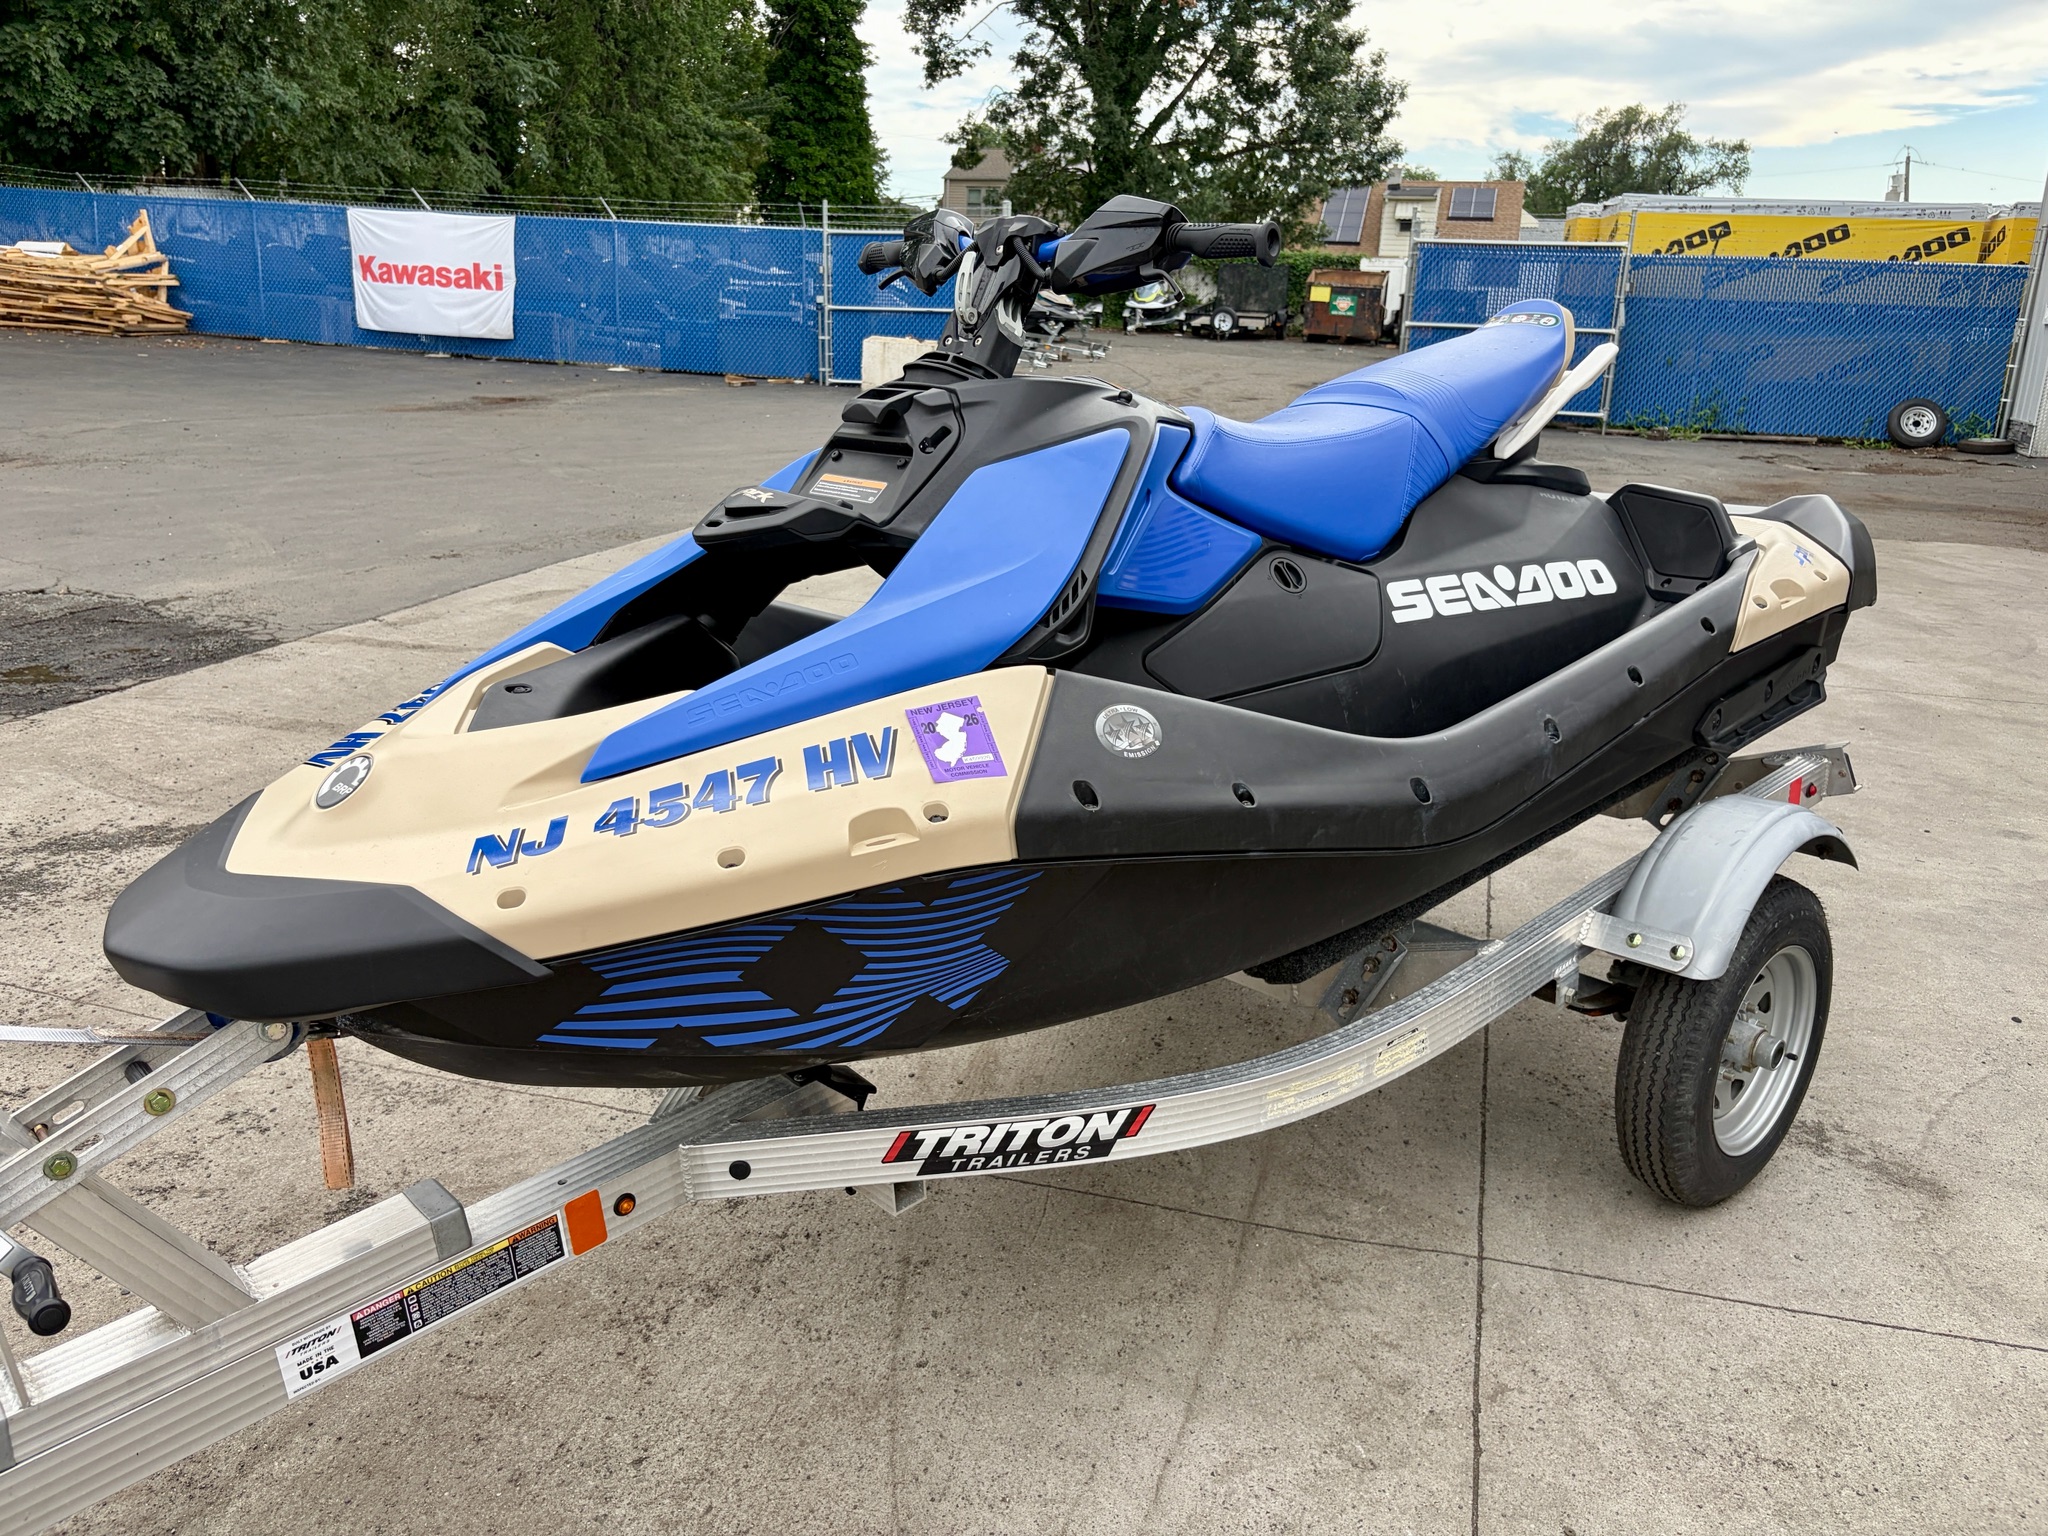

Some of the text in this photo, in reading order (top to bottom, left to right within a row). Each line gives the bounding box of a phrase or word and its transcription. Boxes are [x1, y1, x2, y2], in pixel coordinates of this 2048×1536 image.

[358, 255, 503, 291] Kawasaki
[910, 698, 974, 716] NEW JERSEY
[1103, 707, 1120, 719] ULTRA
[921, 713, 979, 734] 20 26
[1124, 744, 1156, 758] EMISSION
[944, 765, 966, 773] MOTOR
[332, 782, 353, 796] BRP
[466, 815, 569, 876] NJ
[594, 756, 784, 837] 4547
[803, 726, 898, 792] HV
[913, 1108, 1132, 1160] TRITON
[951, 1145, 1092, 1172] TRAILERS
[519, 1217, 555, 1239] WARNING
[415, 1267, 453, 1289] CAUTION
[363, 1293, 401, 1317] DANGER
[291, 1328, 337, 1356] TRITON
[297, 1355, 313, 1367] MADE
[324, 1345, 335, 1354] THE
[299, 1355, 340, 1380] USA
